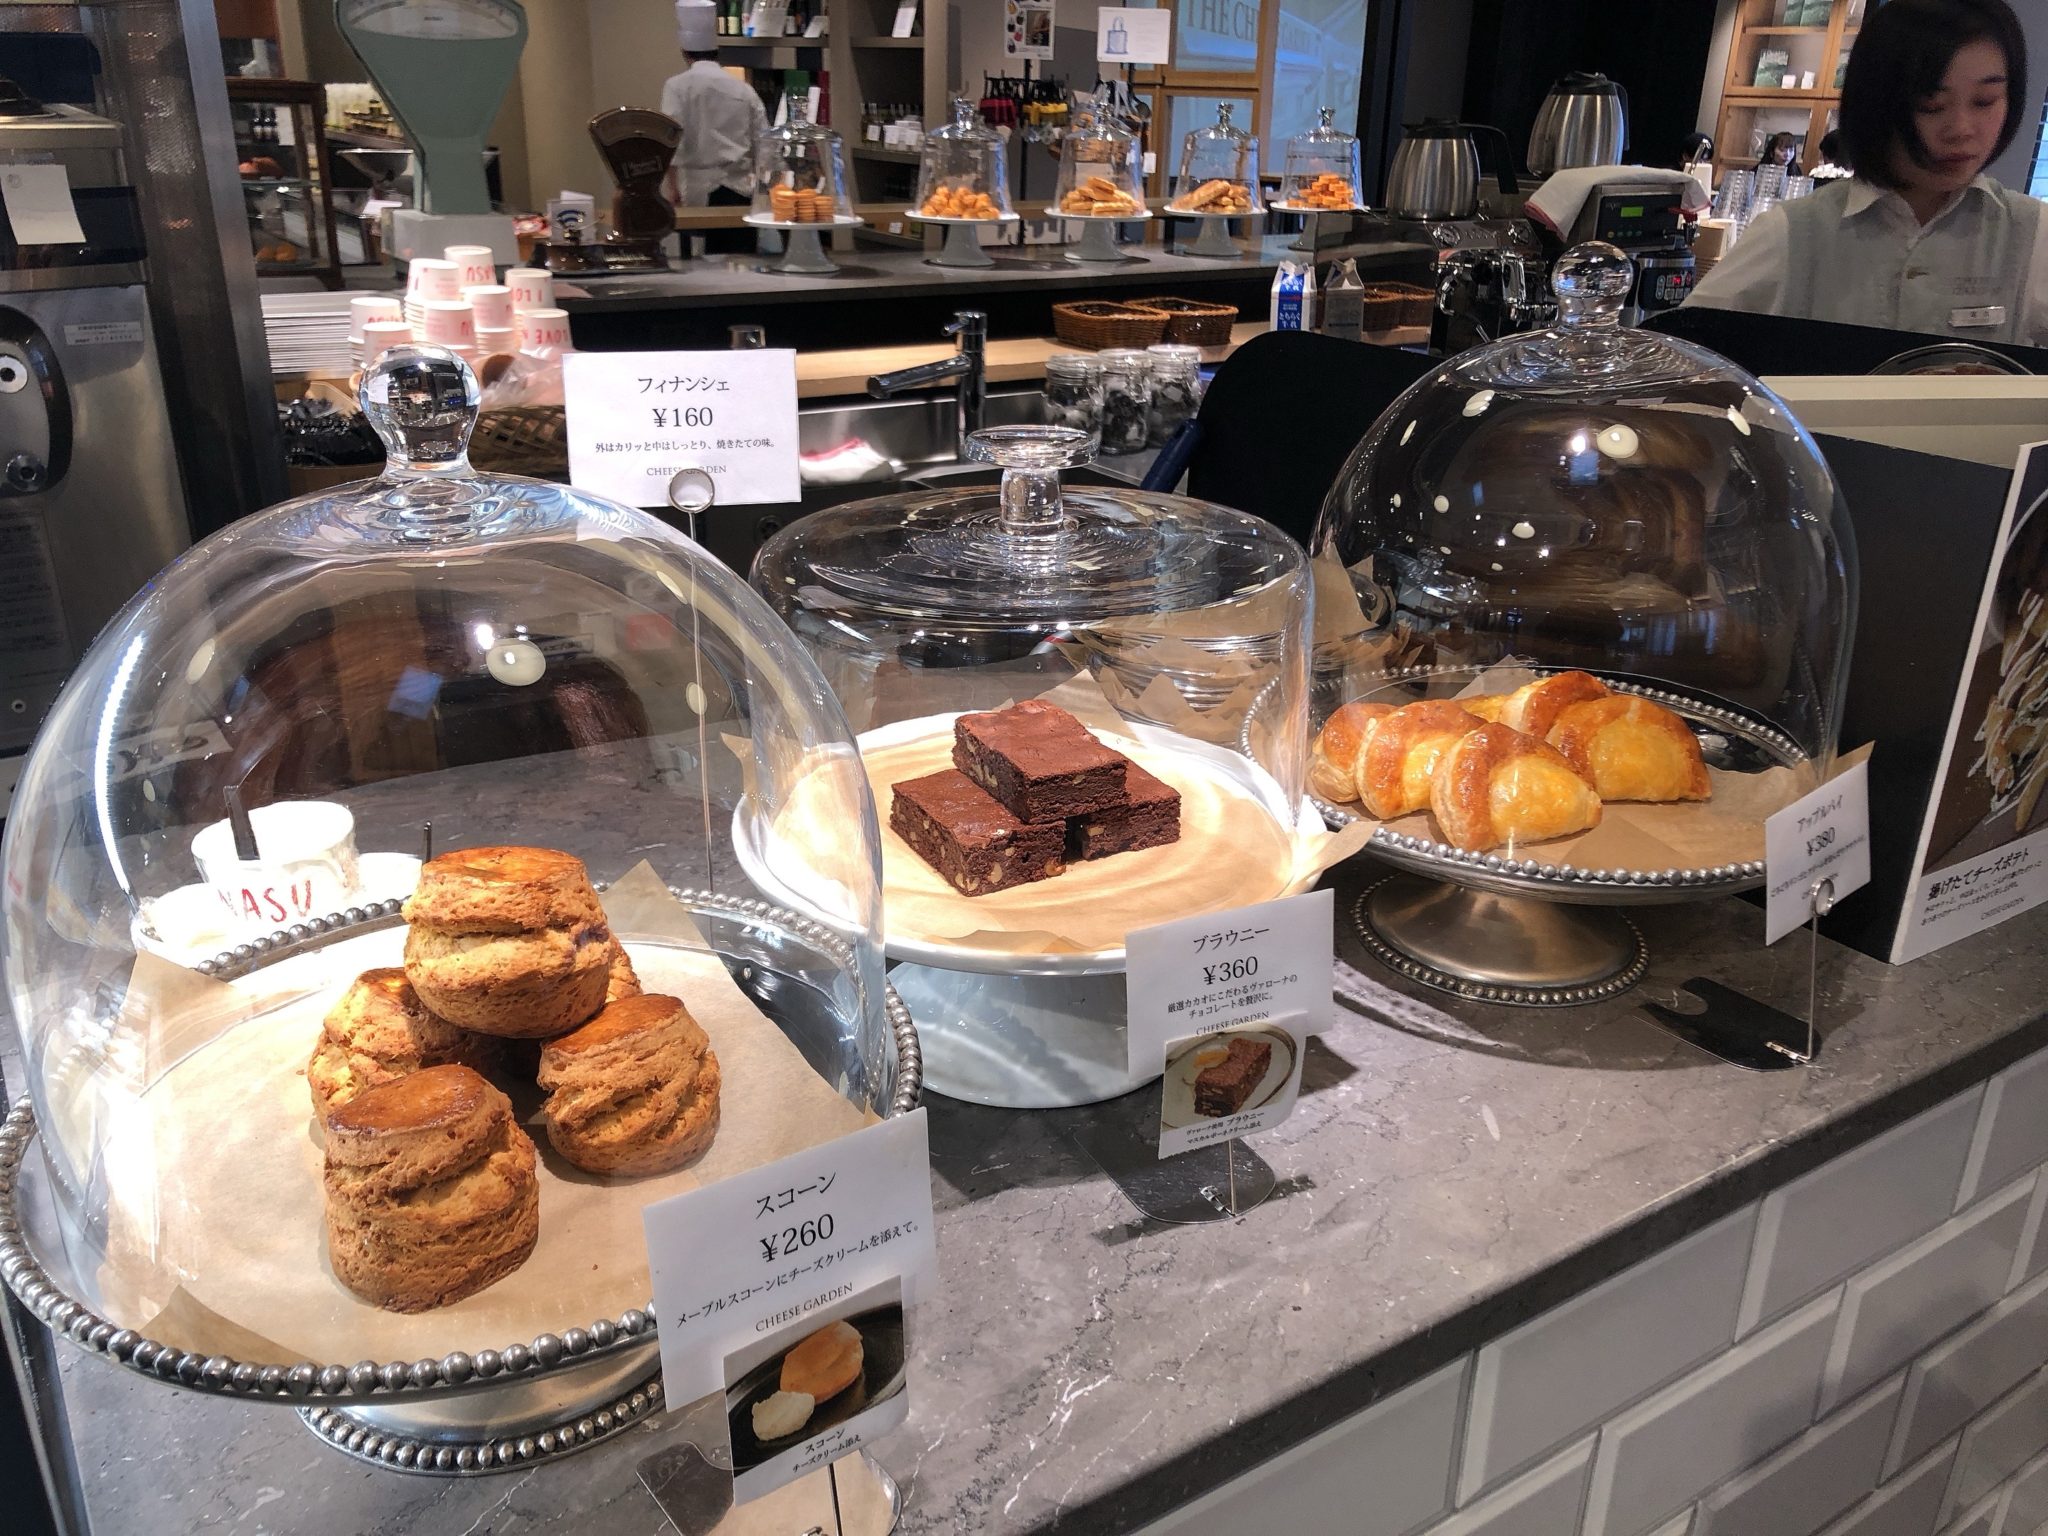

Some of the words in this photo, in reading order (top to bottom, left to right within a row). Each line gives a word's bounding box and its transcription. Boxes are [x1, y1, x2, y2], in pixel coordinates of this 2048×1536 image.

[638, 376, 730, 394] フィナンシェ
[652, 407, 714, 428] ¥160
[595, 438, 776, 453] 外はカリッと中はしっとり、焼きたての味。
[646, 466, 682, 476] CHEES
[1193, 927, 1270, 954] ブラウニー
[1203, 956, 1259, 986] ¥360
[1167, 974, 1298, 1014] 厳選カカオにこだわるヴァローナの
[1196, 1020, 1230, 1035] CHEESE
[1231, 1011, 1270, 1026] GARDEN
[755, 1172, 837, 1219] スコーン
[760, 1213, 835, 1263] ¥260
[676, 1220, 919, 1328] メープルスコーンにチーズクリームを添えて。
[755, 1305, 803, 1332] CHEESE
[803, 1283, 854, 1313] GARDEN
[805, 1428, 846, 1456] スコーン
